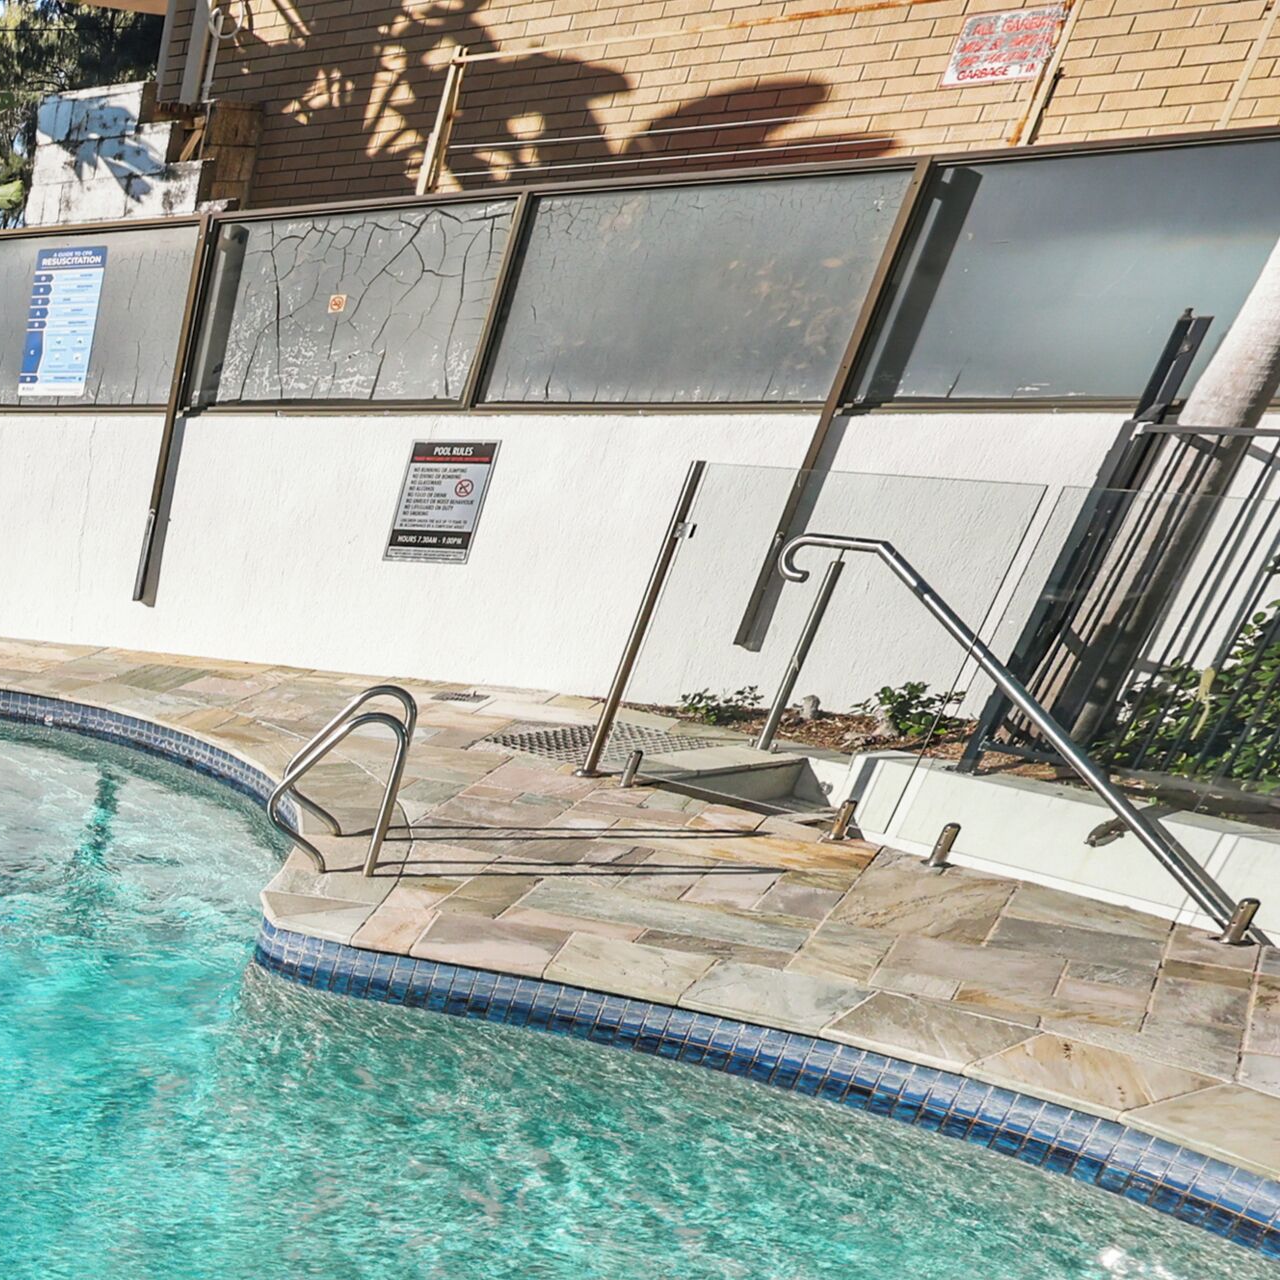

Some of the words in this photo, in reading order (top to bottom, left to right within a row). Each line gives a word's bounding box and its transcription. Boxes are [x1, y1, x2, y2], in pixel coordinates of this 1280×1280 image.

[956, 65, 1009, 82] GARBAGE
[41, 255, 102, 266] RESUSCITATION
[433, 446, 451, 456] POOL
[451, 447, 474, 456] RULES
[397, 535, 417, 543] HOURS
[417, 536, 437, 544] 7.30AM
